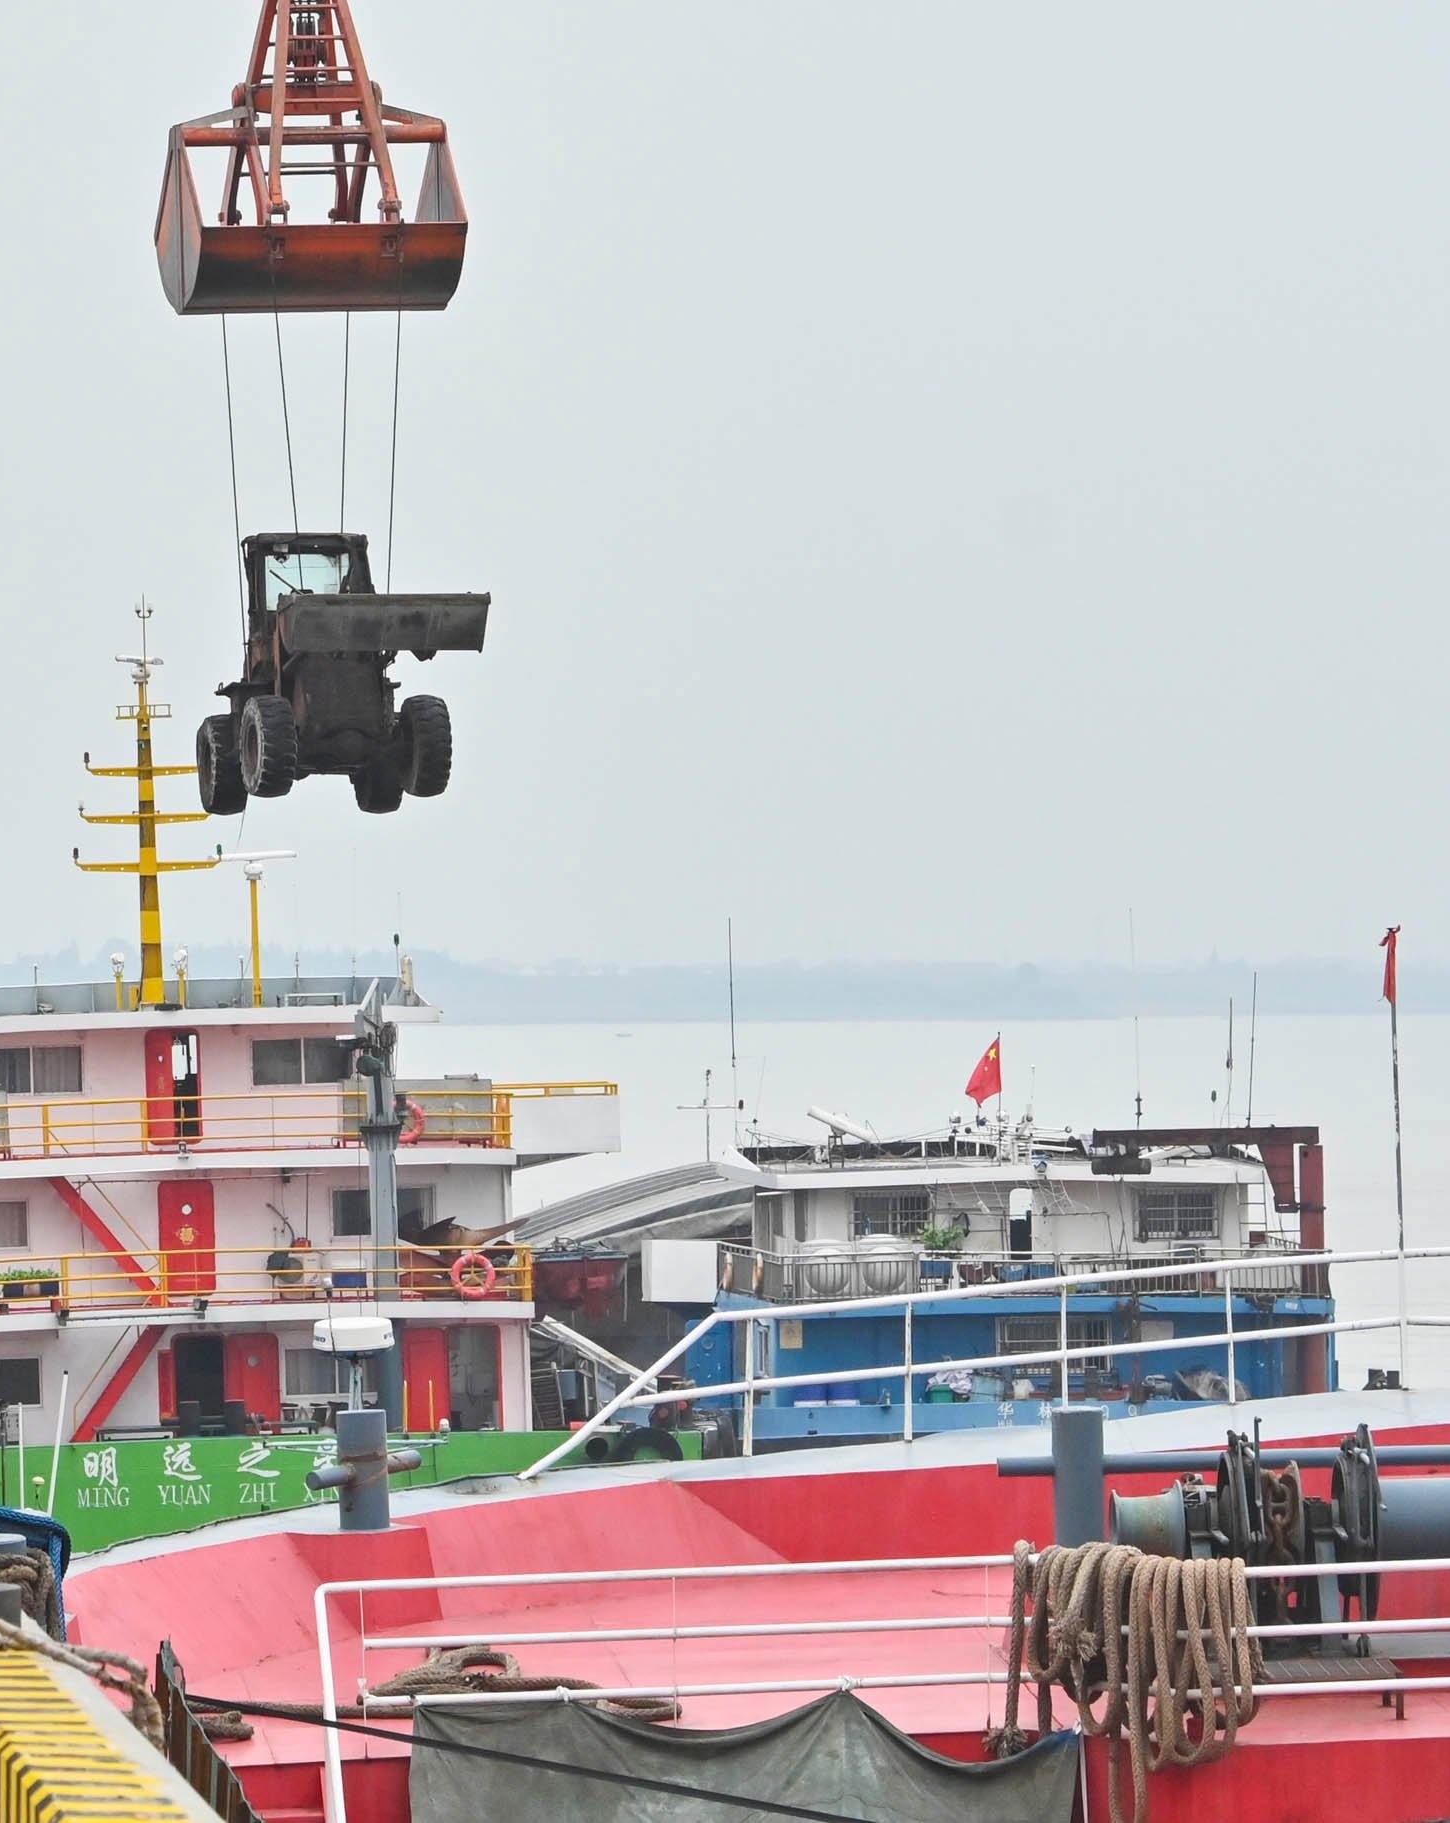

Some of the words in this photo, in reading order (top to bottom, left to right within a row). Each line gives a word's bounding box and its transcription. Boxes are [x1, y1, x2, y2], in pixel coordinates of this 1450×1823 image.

[77, 1486, 131, 1508] MING
[157, 1483, 212, 1506] YUAN
[238, 1482, 276, 1504] ZHI
[303, 1482, 339, 1502] XIN
